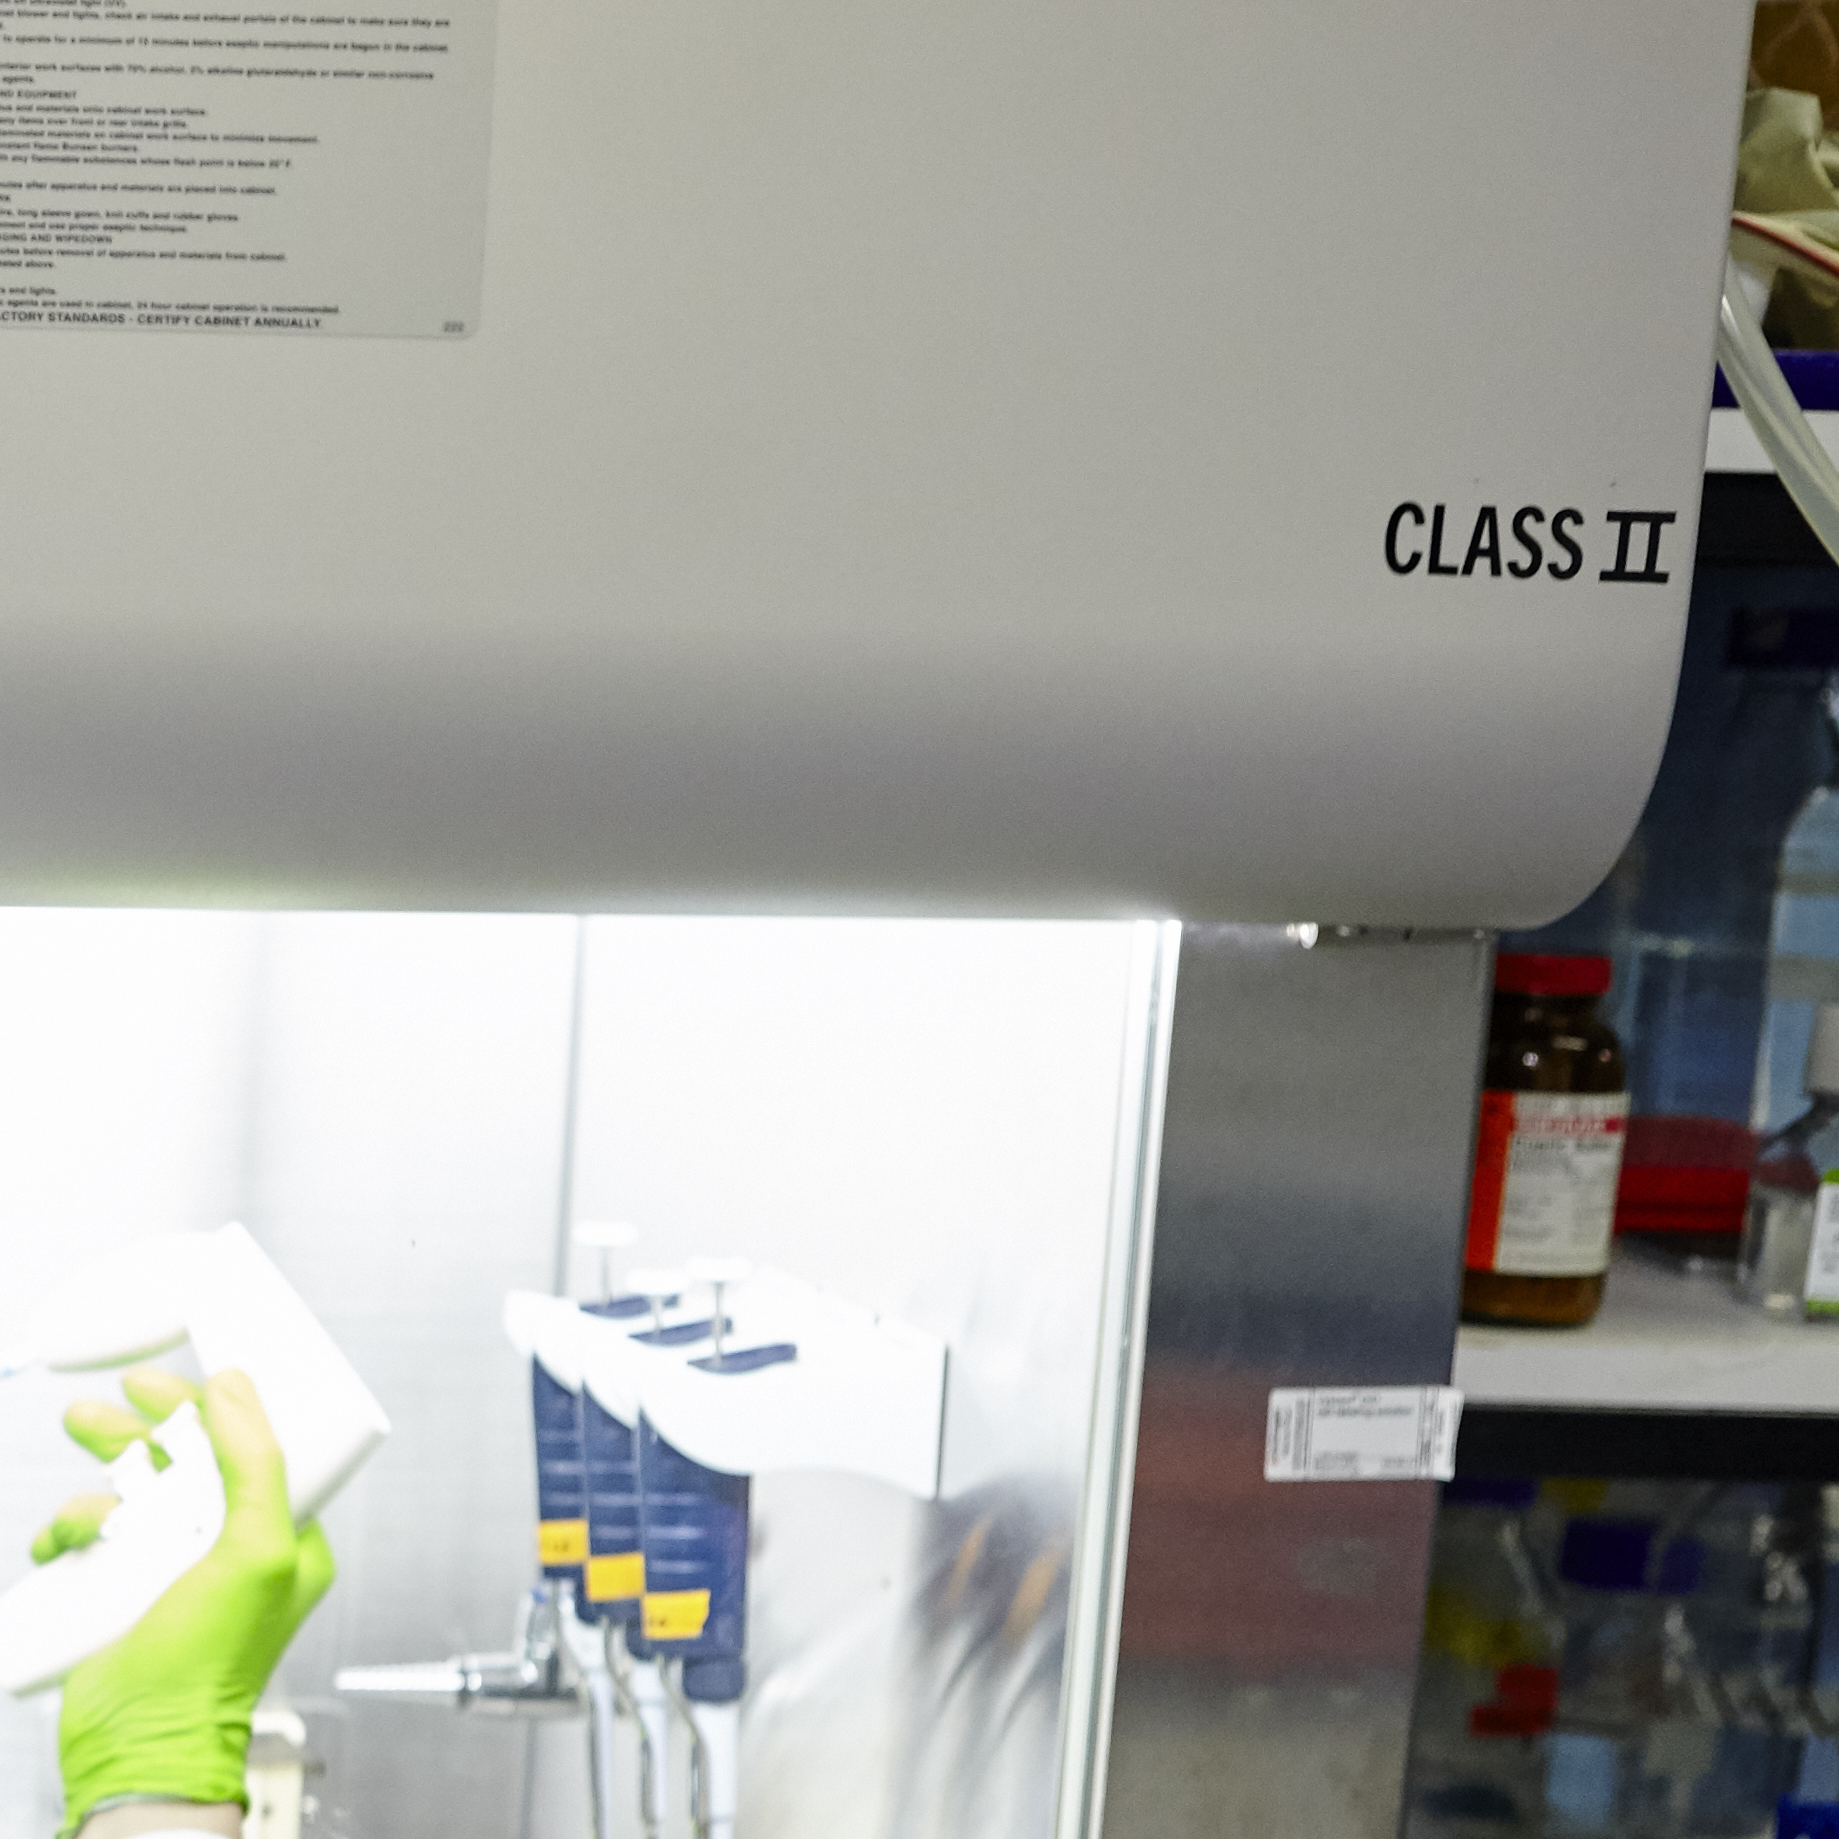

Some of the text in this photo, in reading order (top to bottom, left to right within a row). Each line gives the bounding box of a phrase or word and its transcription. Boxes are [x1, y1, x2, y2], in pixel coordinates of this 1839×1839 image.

[48, 313, 125, 323] STANDARDS
[137, 315, 190, 325] CERTIFY
[195, 316, 250, 326] CABINET
[254, 317, 322, 328] ANNUALLY
[1385, 501, 1676, 584] CLASS II
